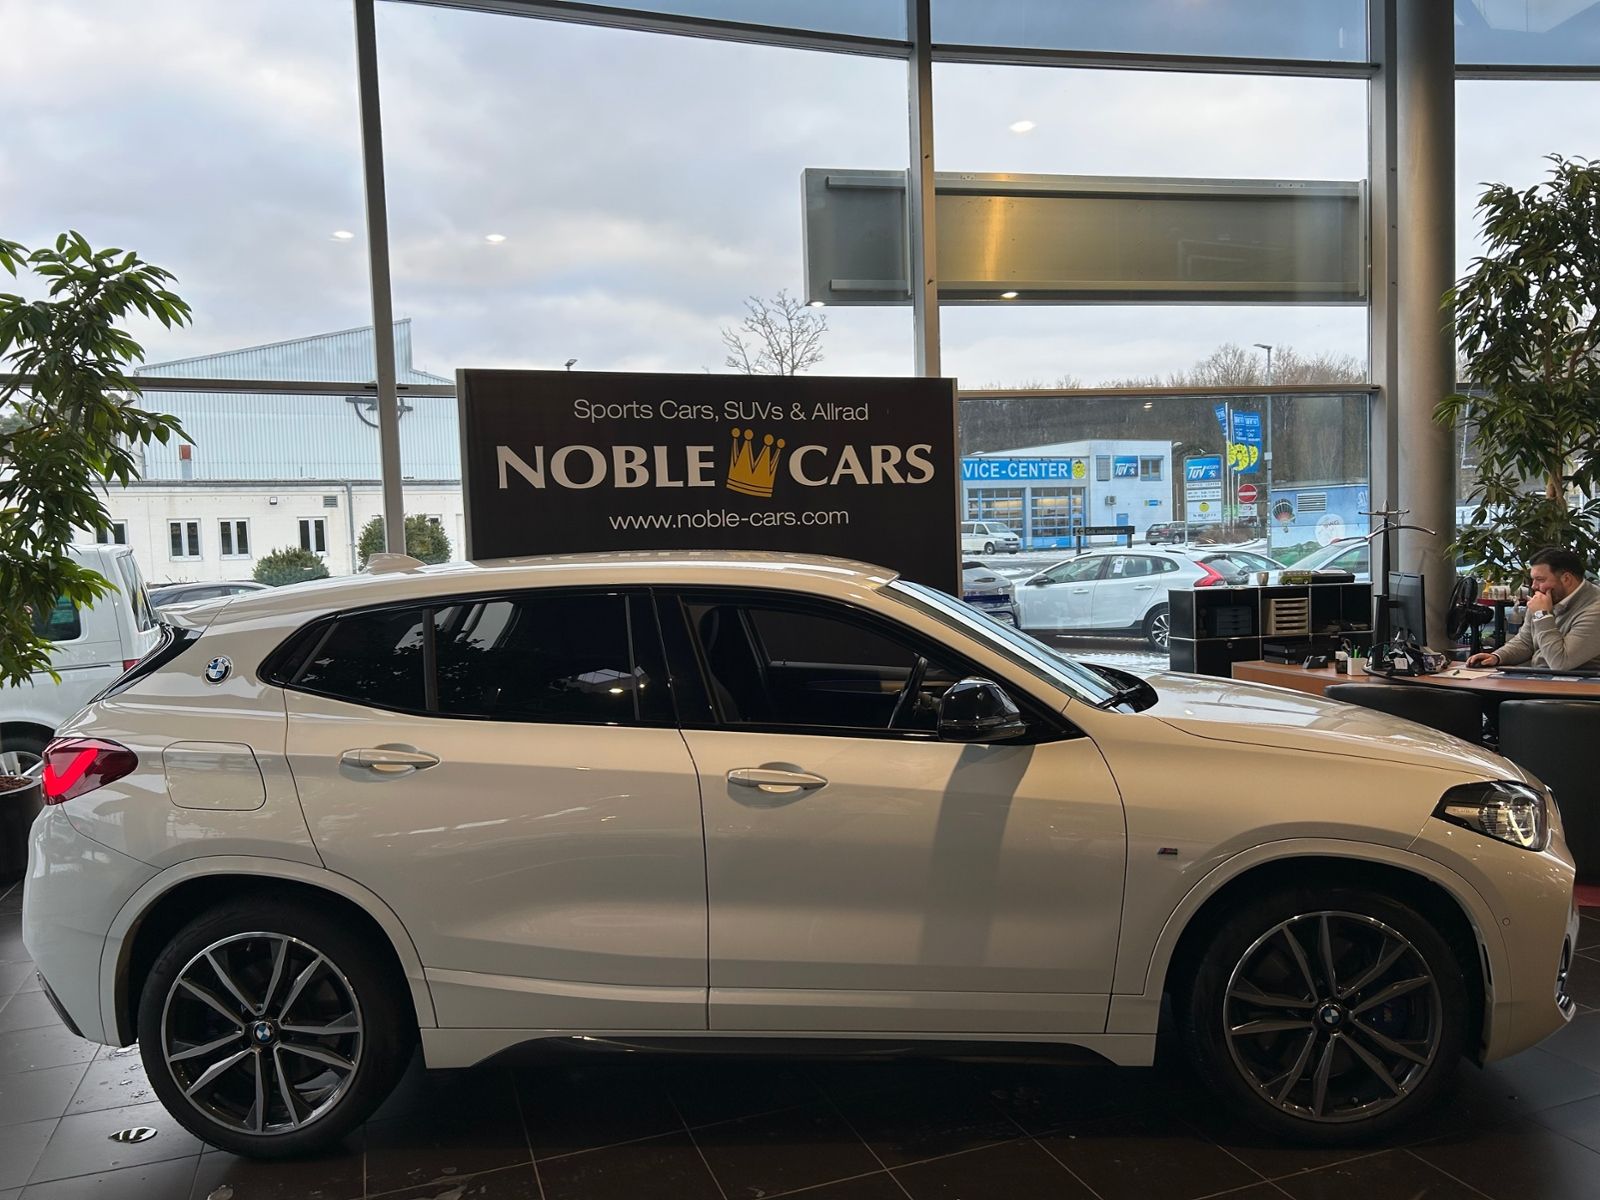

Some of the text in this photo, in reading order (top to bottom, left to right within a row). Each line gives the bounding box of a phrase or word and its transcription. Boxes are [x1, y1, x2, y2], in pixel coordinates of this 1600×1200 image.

[574, 399, 868, 423] Sports Cars, SUVs & Allrad
[497, 444, 934, 489] NOBLE CARS
[609, 509, 848, 529] www.noble-cars.com
